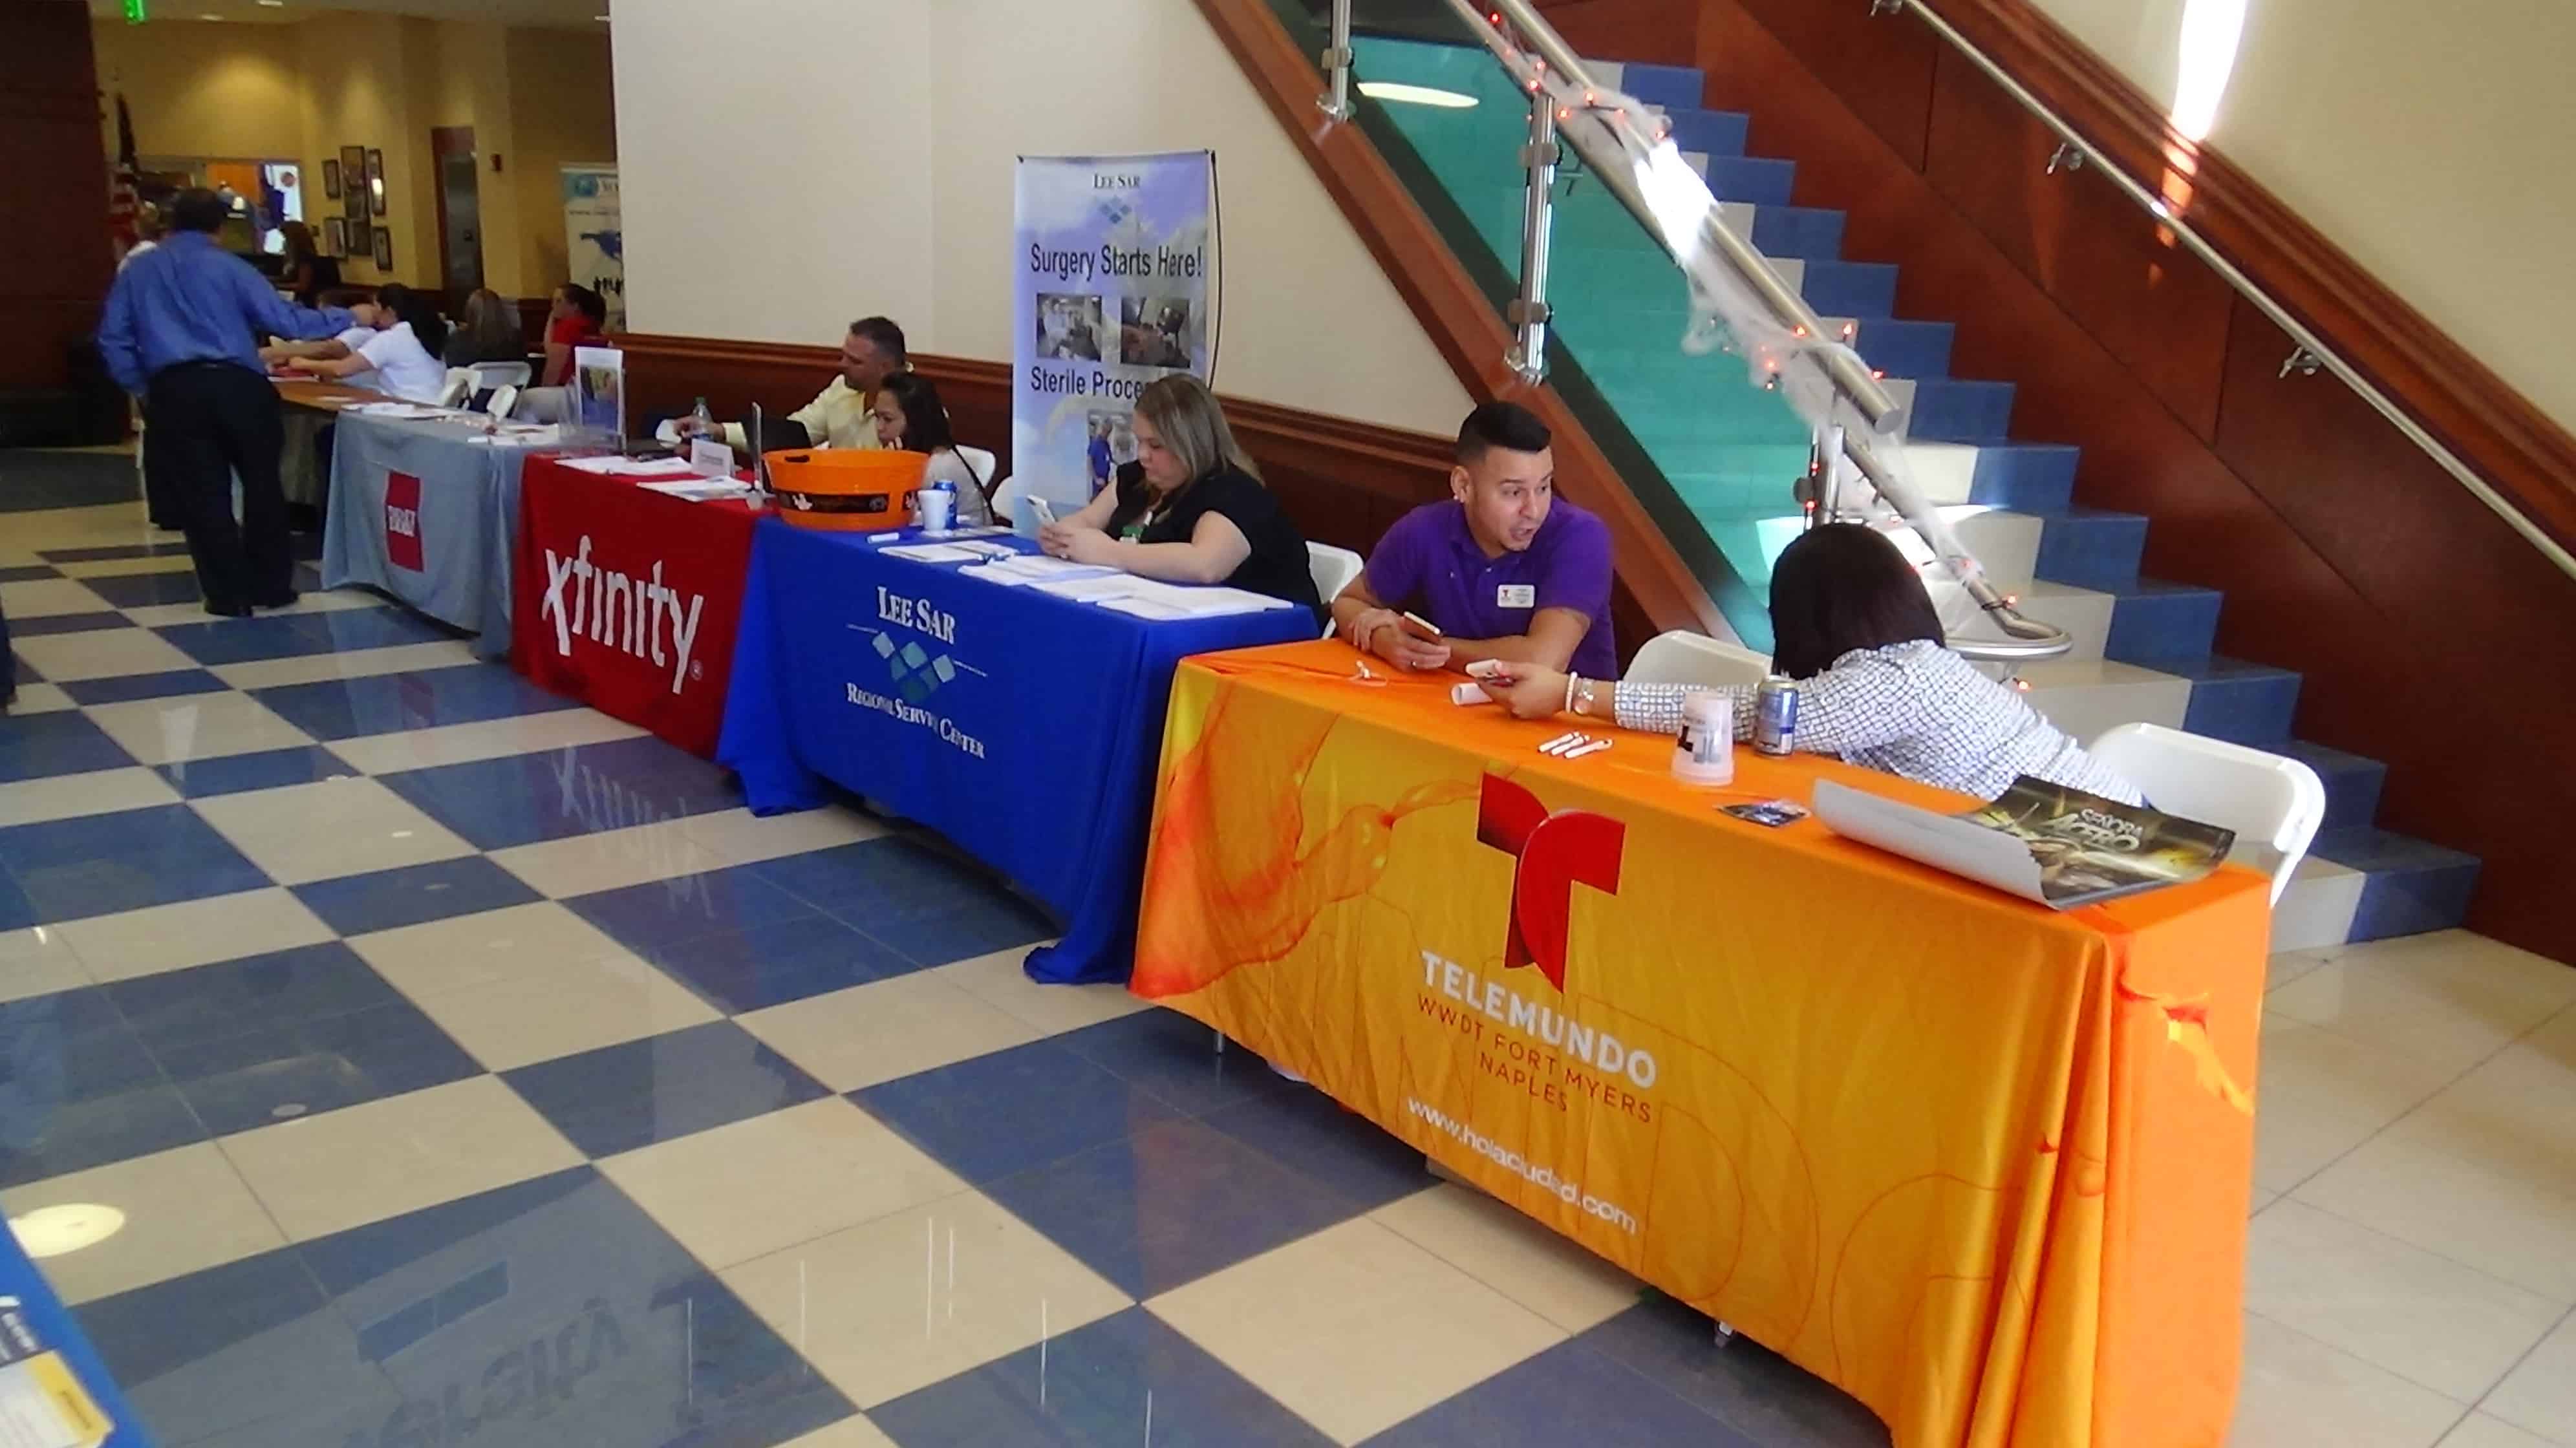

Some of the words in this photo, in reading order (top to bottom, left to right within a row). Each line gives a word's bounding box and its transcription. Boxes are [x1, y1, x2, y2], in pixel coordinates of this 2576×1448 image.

[1031, 242, 1095, 282] Surgery
[1100, 244, 1151, 276] Starts
[1157, 246, 1202, 277] Here!
[1031, 366, 1086, 395] Sterile
[1092, 371, 1144, 400] Proce
[541, 535, 704, 695] xfinity
[877, 586, 913, 627] LEE
[916, 598, 956, 645] SAR
[895, 697, 938, 734] SERVI
[940, 718, 985, 760] CENTER
[1422, 949, 1657, 1089] TELEMUNDO
[1417, 992, 1484, 1041] WWDT
[1494, 1032, 1556, 1076] FORT
[1565, 1067, 1651, 1123] MYERS
[1480, 1051, 1567, 1113] NAPLES
